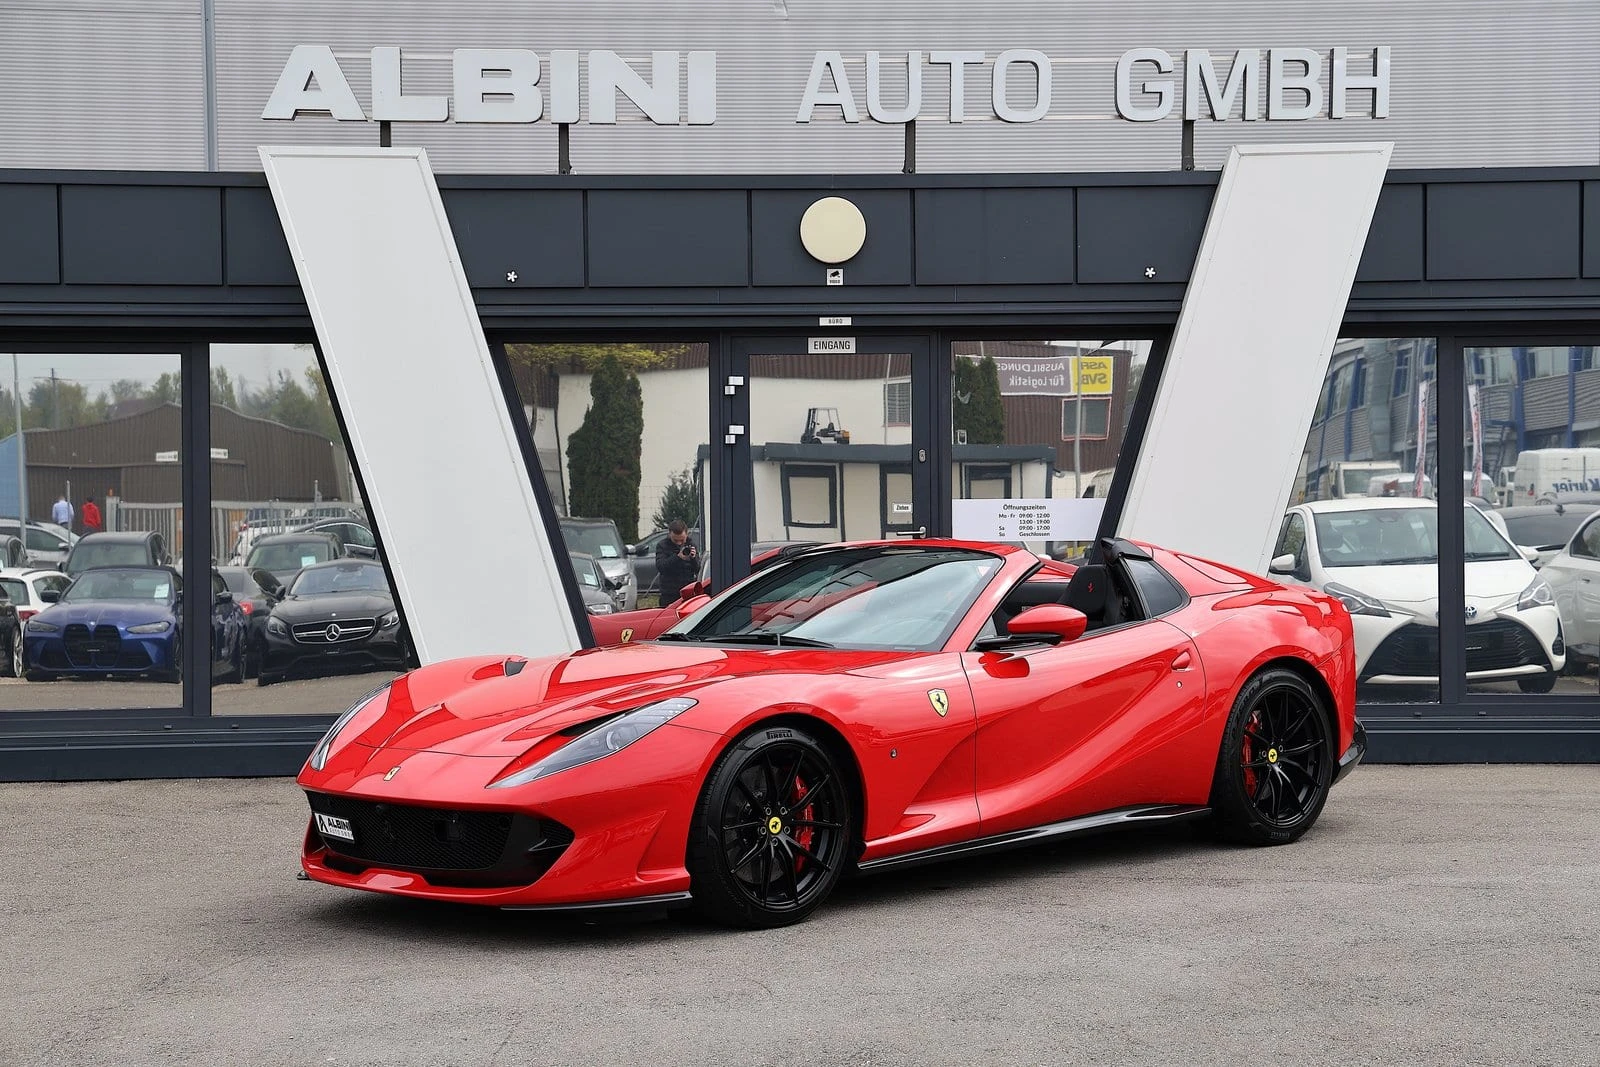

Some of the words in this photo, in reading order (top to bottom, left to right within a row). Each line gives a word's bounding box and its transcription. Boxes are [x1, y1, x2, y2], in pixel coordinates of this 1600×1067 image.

[261, 44, 717, 125] ALBINI
[796, 48, 1053, 124] AUTO
[1114, 45, 1391, 122] GMBH
[813, 340, 851, 350] EINGANG
[766, 730, 793, 740] PIRELLI
